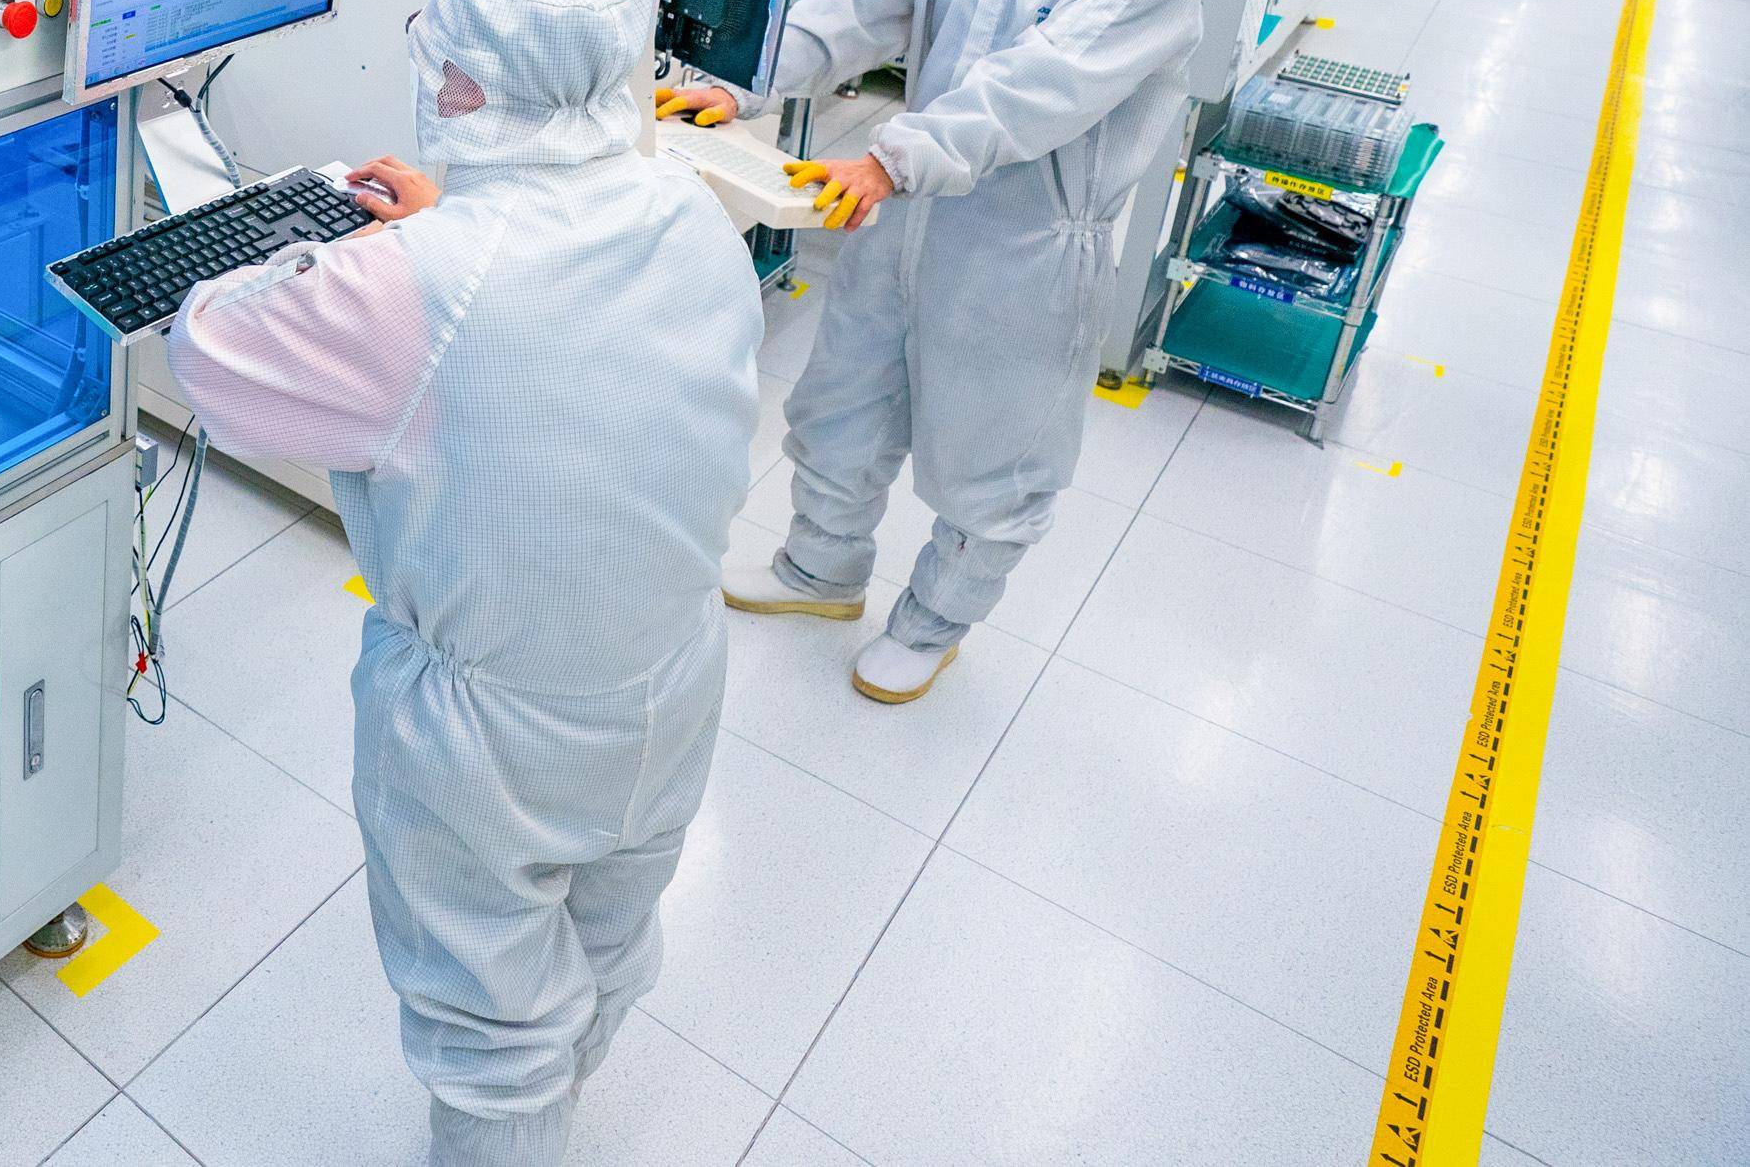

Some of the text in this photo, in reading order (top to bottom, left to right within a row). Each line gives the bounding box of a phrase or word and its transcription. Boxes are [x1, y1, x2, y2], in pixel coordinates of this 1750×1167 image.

[1502, 614, 1514, 628] ESD
[1476, 680, 1501, 748] ESD Protected Area
[1443, 811, 1472, 896] ESD Protected Area
[1403, 976, 1438, 1083] ESD Protected Area
